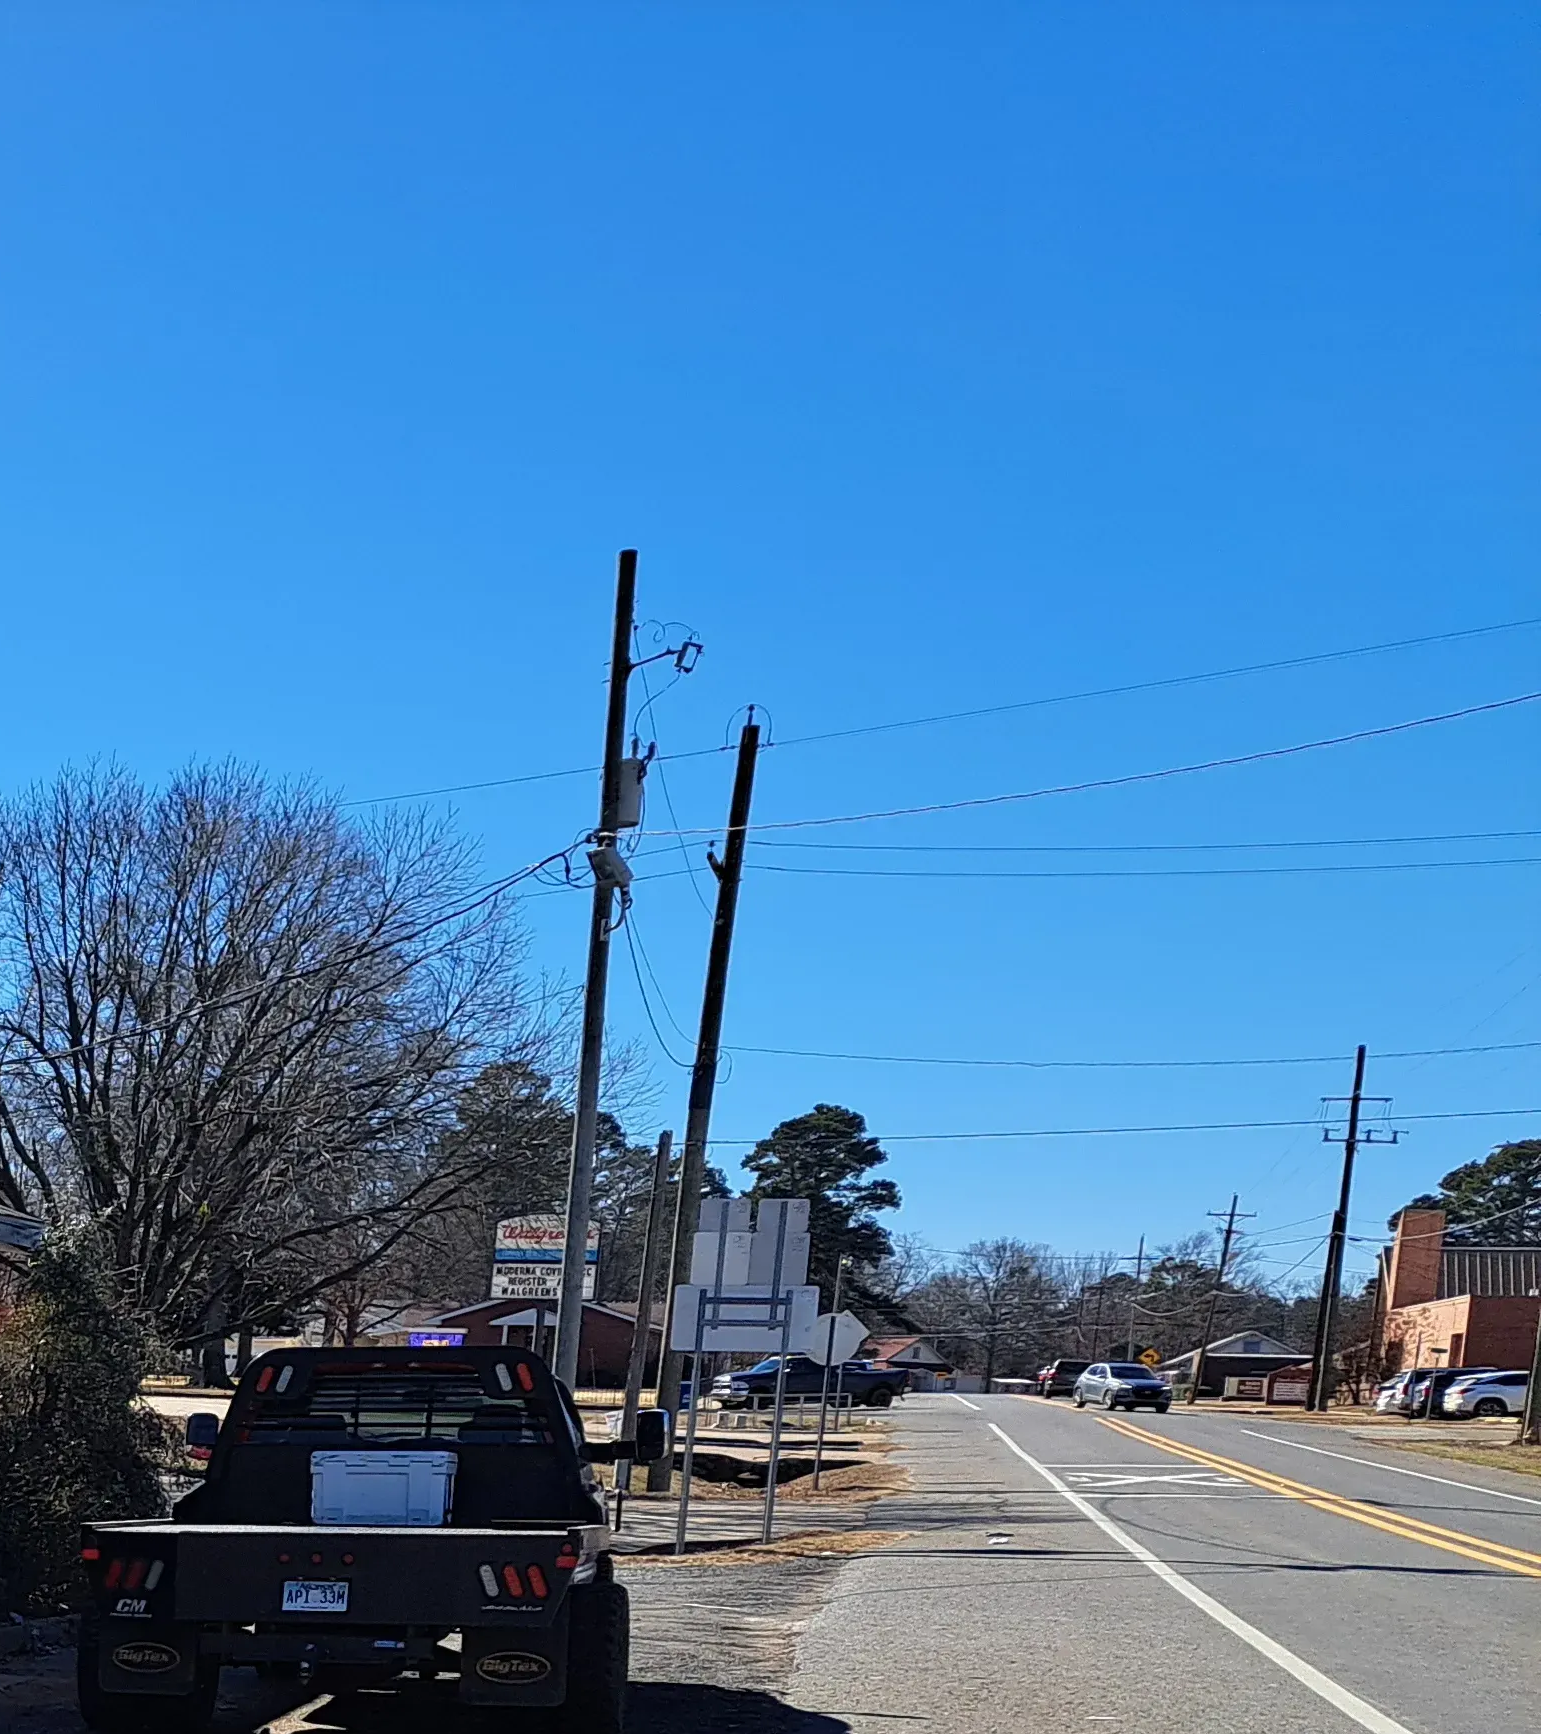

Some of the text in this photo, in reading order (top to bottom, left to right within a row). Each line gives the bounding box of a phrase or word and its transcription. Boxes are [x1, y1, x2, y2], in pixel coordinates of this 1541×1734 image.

[496, 1266, 537, 1277] MODERNA
[508, 1276, 548, 1287] REGISTER
[501, 1287, 559, 1297] WALGREENS
[116, 1598, 147, 1612] CM
